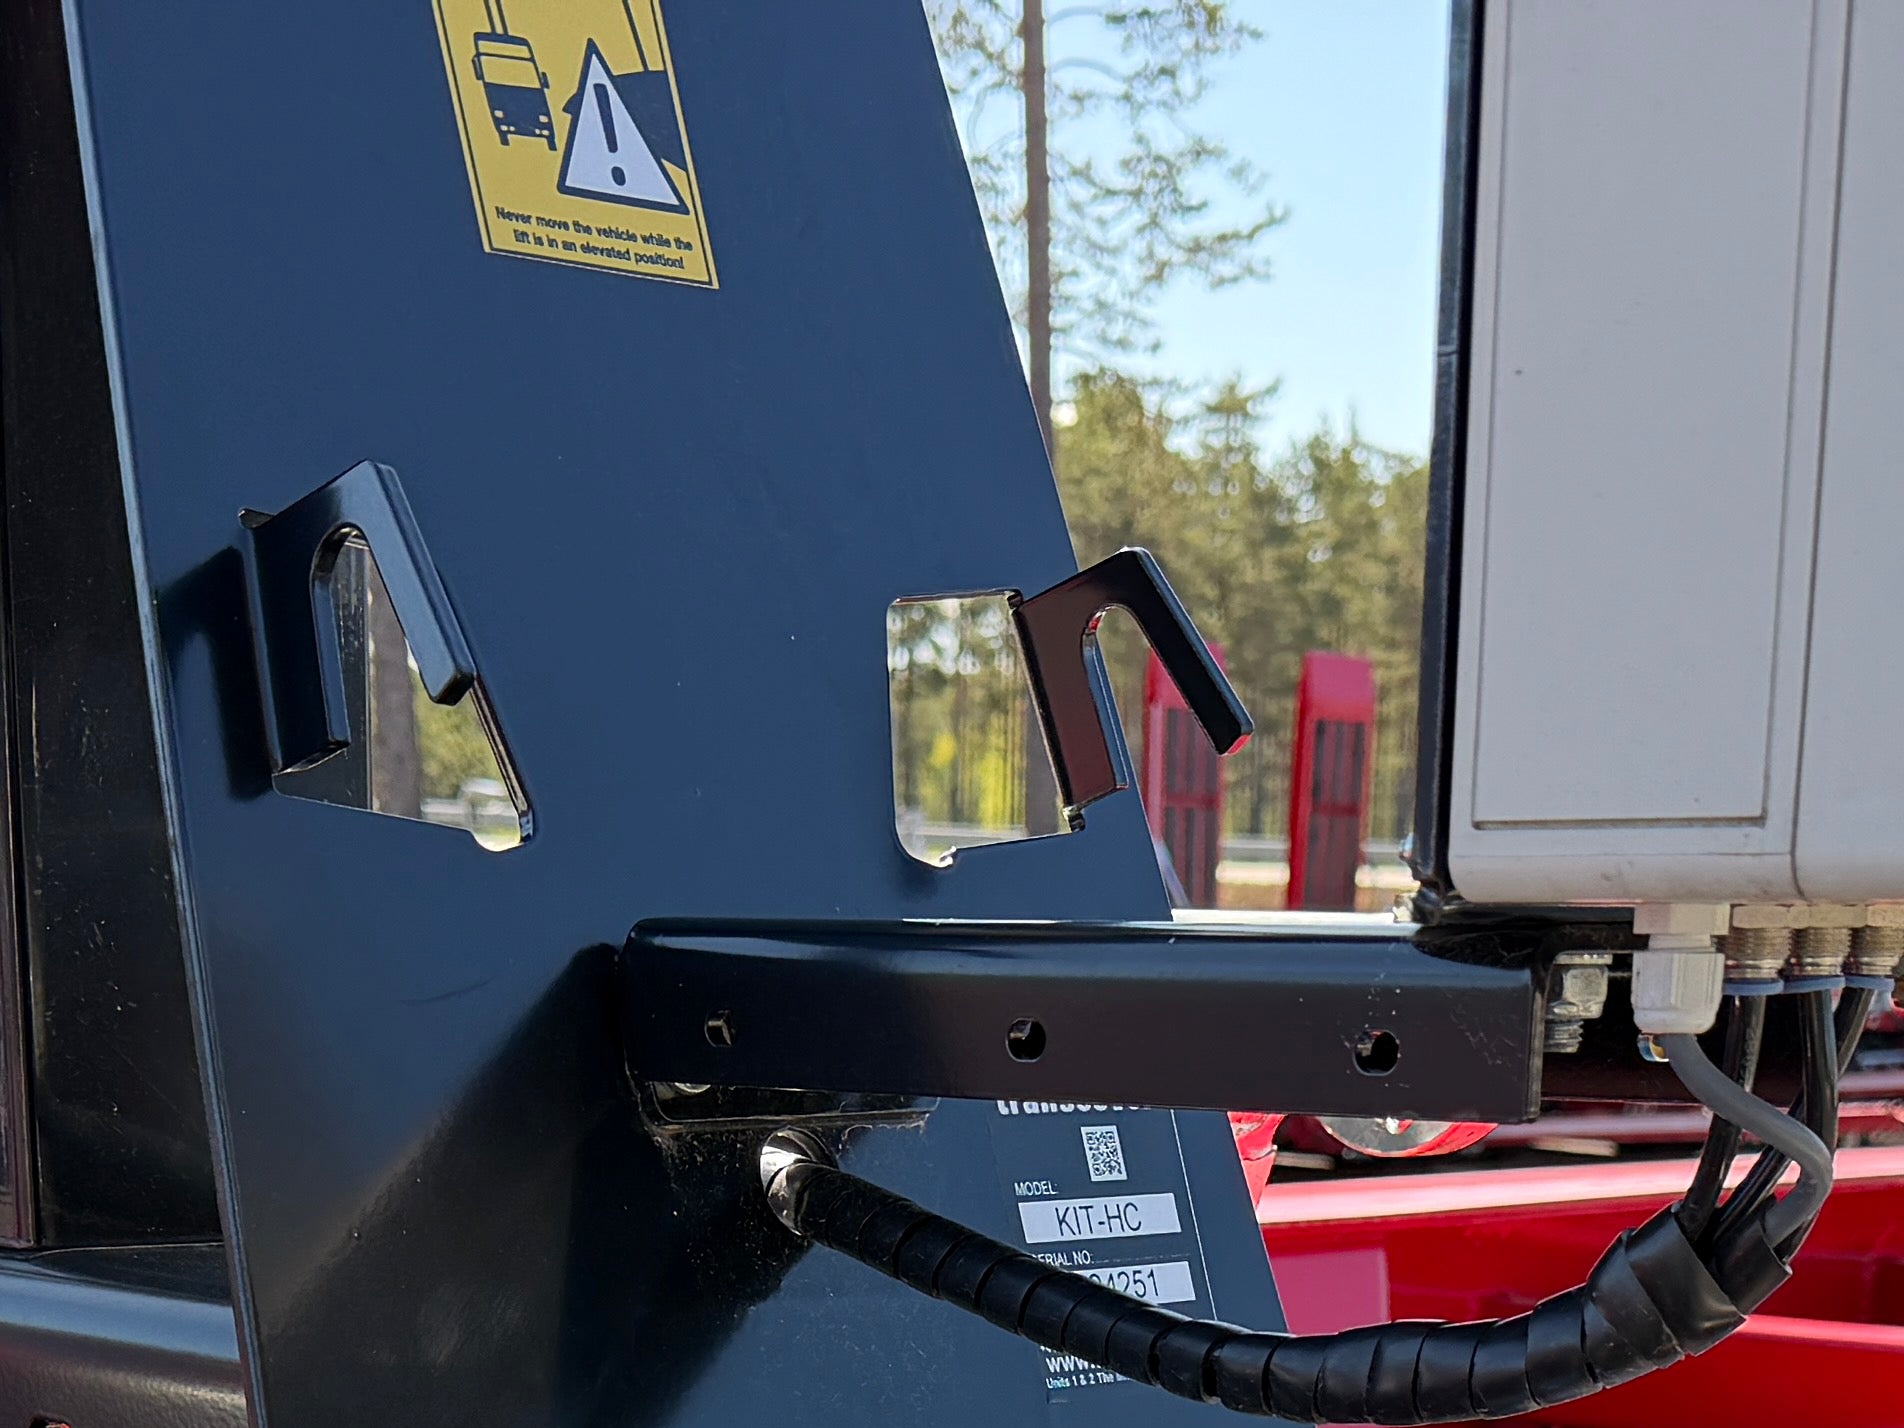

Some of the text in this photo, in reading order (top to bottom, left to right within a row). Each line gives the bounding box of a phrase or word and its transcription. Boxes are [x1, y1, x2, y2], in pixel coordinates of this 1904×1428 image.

[495, 206, 693, 252] Never move the vehicle while the
[514, 229, 531, 245] lift
[562, 239, 577, 253] an
[581, 242, 631, 262] elevated
[634, 252, 685, 270] position!
[1055, 1202, 1142, 1237] KIT-HC
[1032, 1252, 1073, 1267] ERIAL
